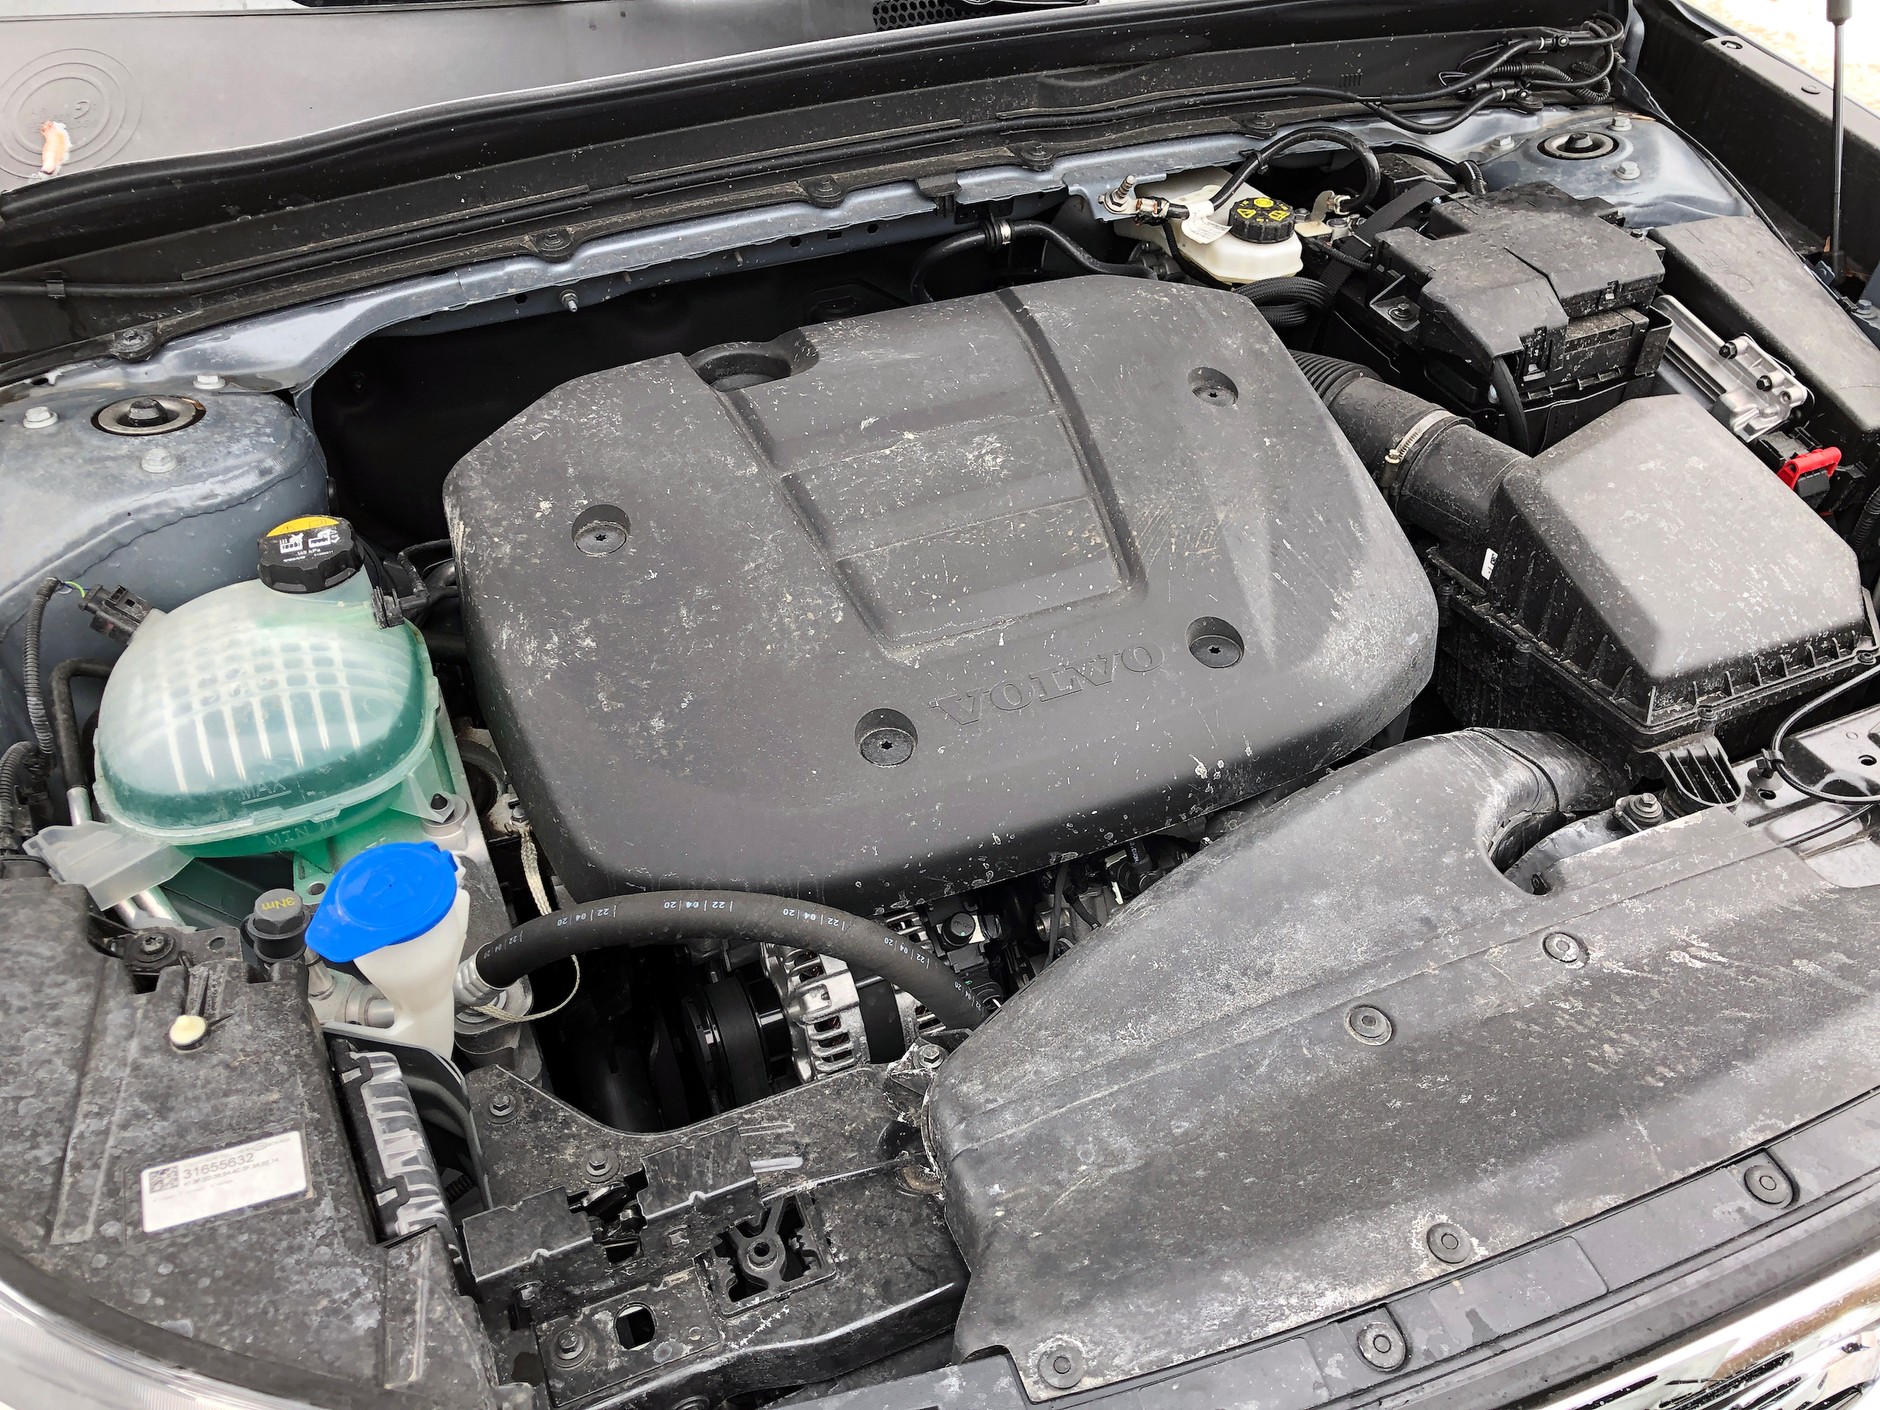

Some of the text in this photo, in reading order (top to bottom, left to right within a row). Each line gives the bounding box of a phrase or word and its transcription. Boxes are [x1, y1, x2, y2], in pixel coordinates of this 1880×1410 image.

[927, 643, 1166, 726] VOLVO
[241, 777, 287, 800] MAX
[264, 825, 311, 846] MIN
[261, 896, 296, 910] 3Nm
[182, 1152, 255, 1179] 31655632
